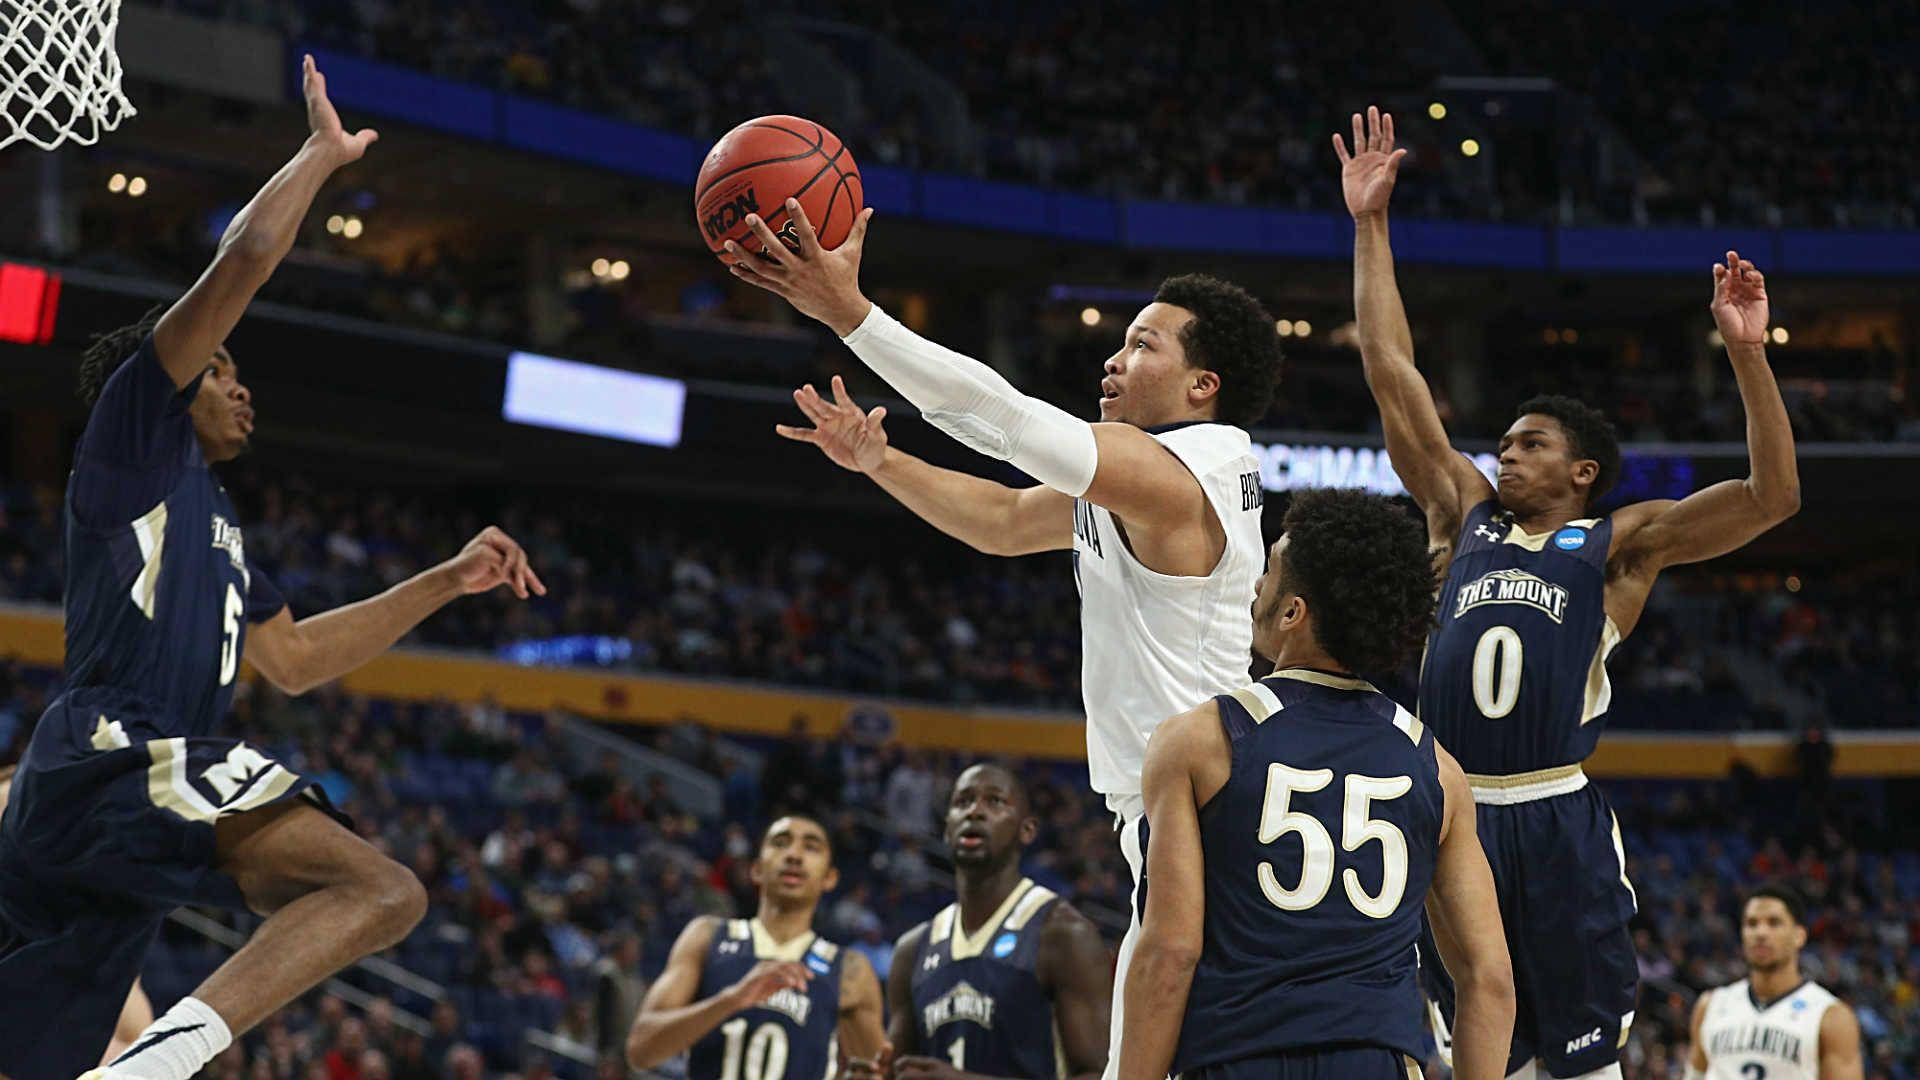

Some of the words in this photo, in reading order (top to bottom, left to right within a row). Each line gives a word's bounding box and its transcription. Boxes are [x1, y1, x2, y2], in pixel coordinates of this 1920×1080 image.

[1457, 578, 1494, 613] THE
[1497, 578, 1568, 620] MOUNT
[220, 582, 243, 686] 5
[1472, 626, 1523, 719] 0
[1257, 762, 1413, 919] 55
[720, 1018, 788, 1080] 10
[947, 1037, 965, 1071] 1
[1566, 1027, 1602, 1055] NEC
[1711, 1025, 1801, 1063] VILLANOVA
